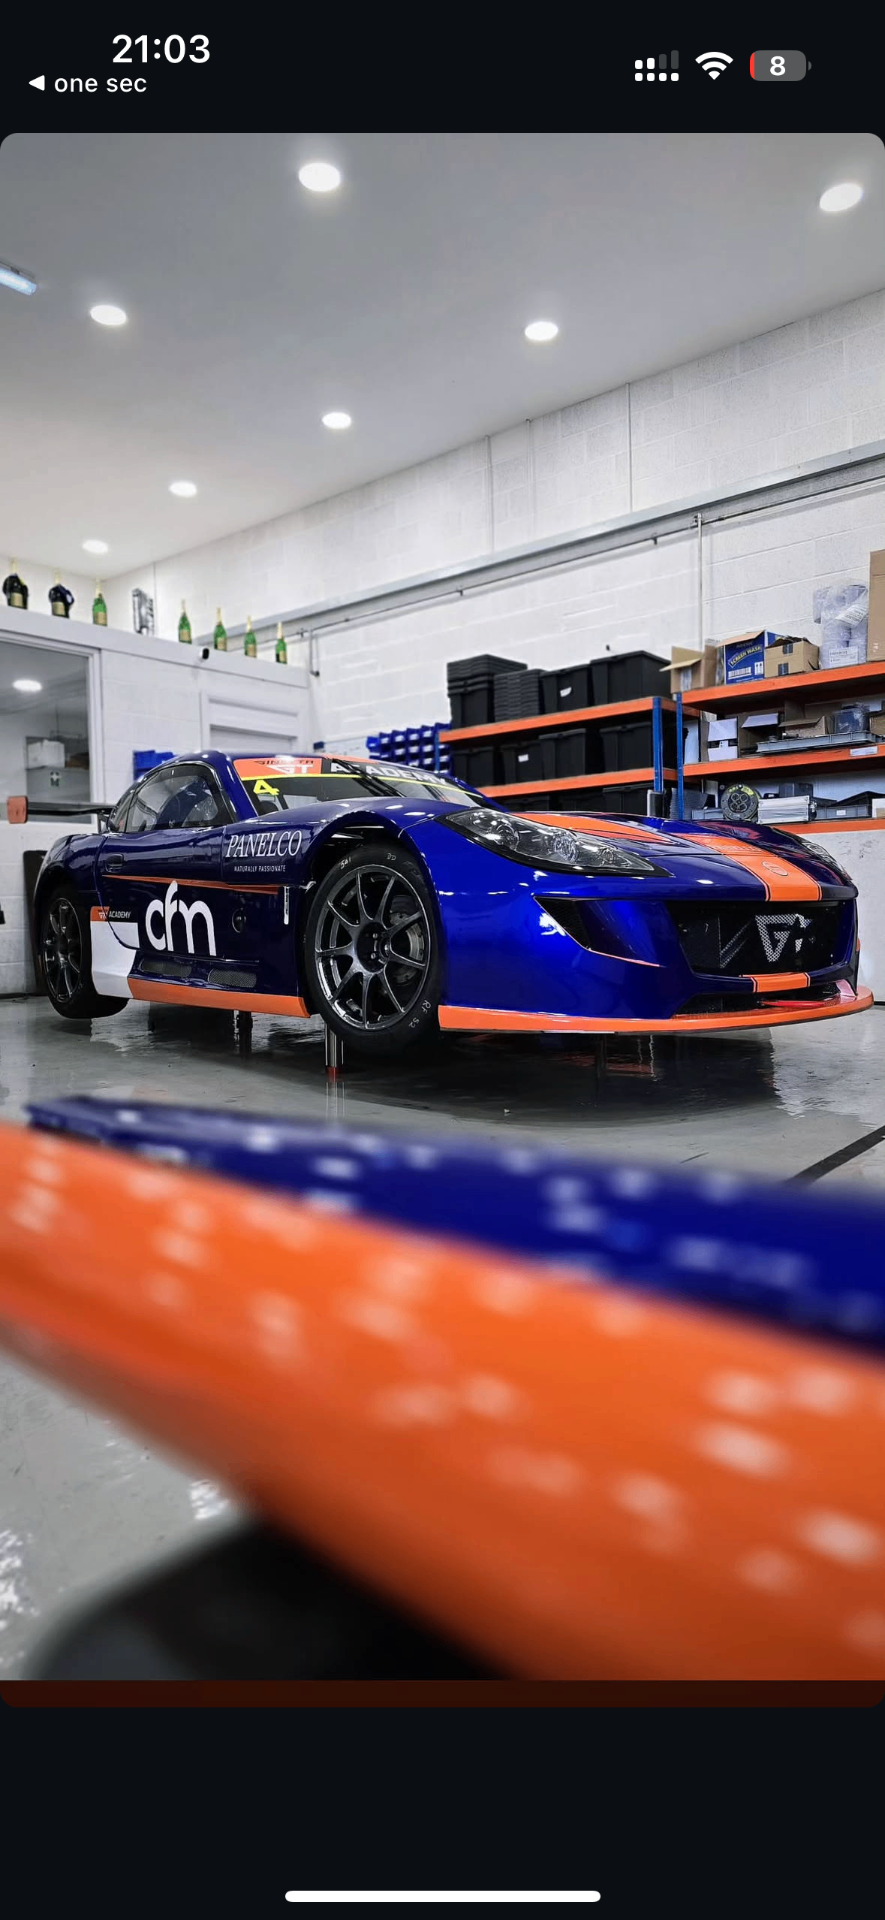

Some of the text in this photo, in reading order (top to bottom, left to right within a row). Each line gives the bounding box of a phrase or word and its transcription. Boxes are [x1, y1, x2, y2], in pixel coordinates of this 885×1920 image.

[253, 779, 280, 796] 4
[225, 830, 302, 858] PANELCO
[233, 864, 286, 873] NATURALLY PASSIONATE
[109, 910, 131, 919] ACADEMY
